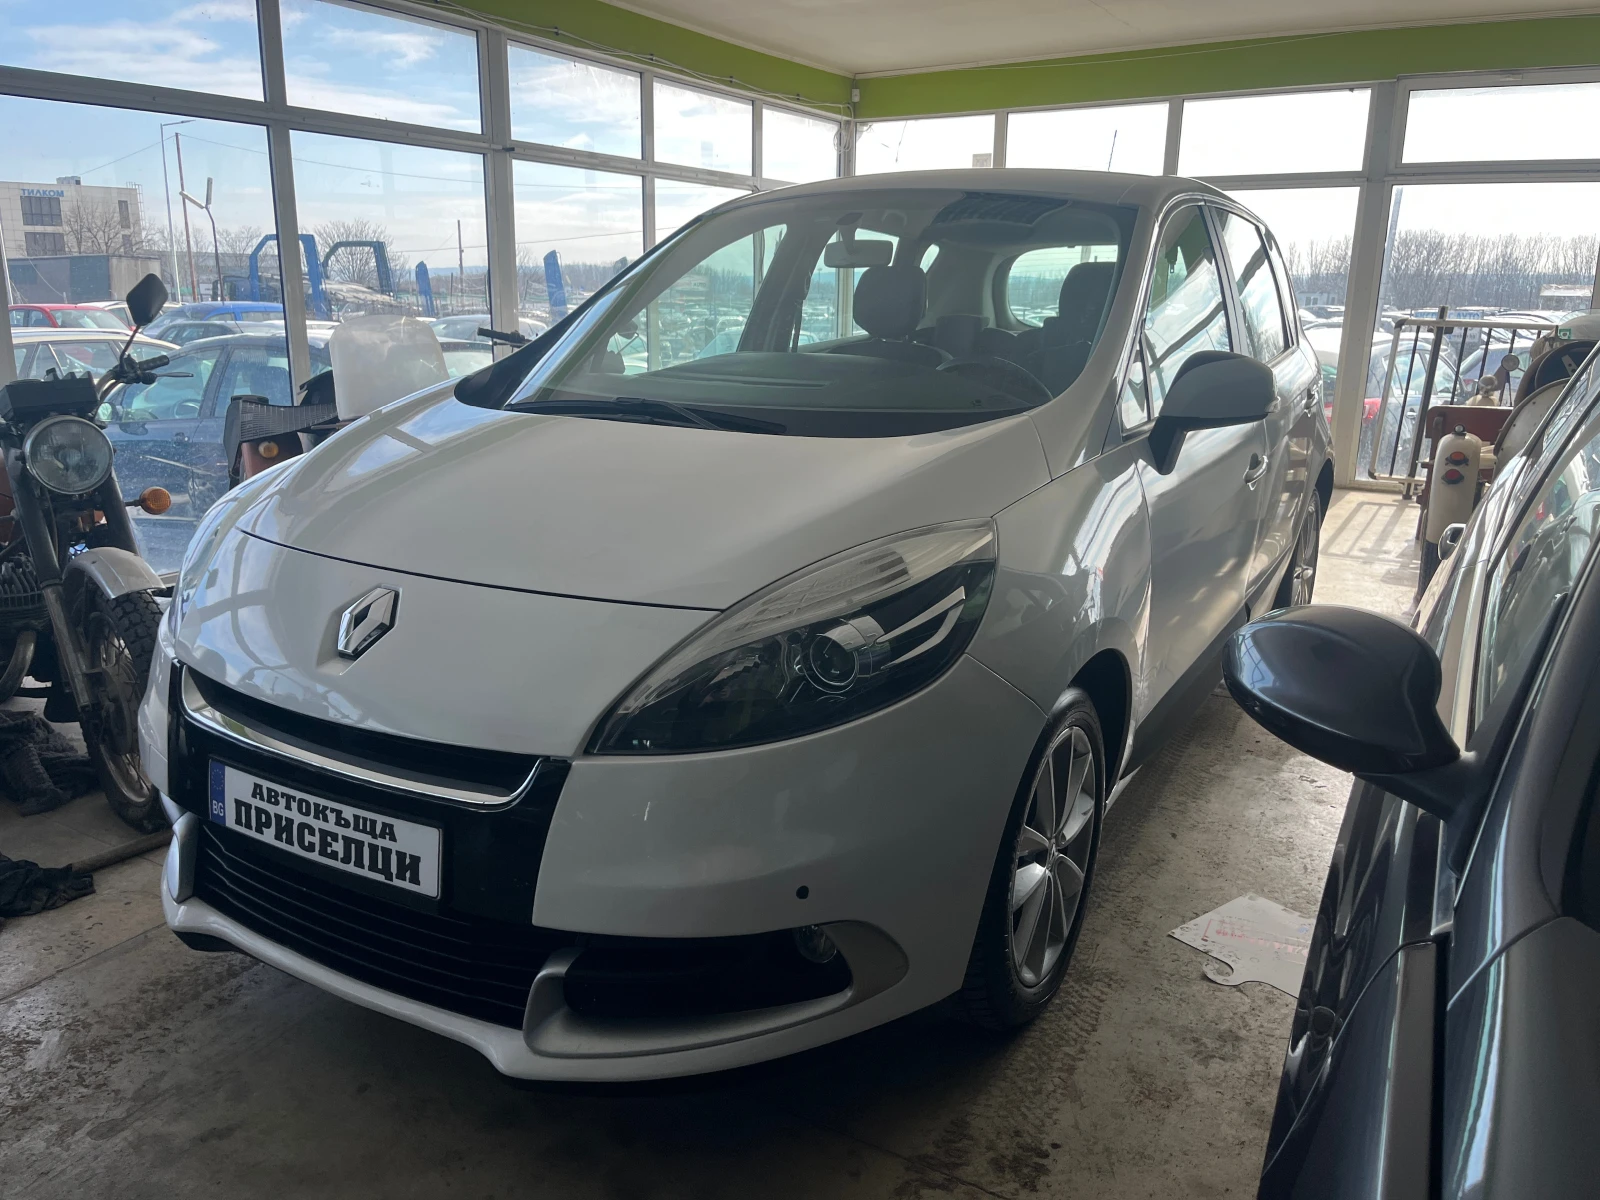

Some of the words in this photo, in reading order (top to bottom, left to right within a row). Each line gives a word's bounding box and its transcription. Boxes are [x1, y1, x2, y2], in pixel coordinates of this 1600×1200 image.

[21, 188, 65, 198] ТИЛКОМ
[212, 799, 224, 817] BG
[251, 782, 398, 843] АВТОКЪЩА
[234, 798, 421, 886] ПРИСЕЛЦИ
